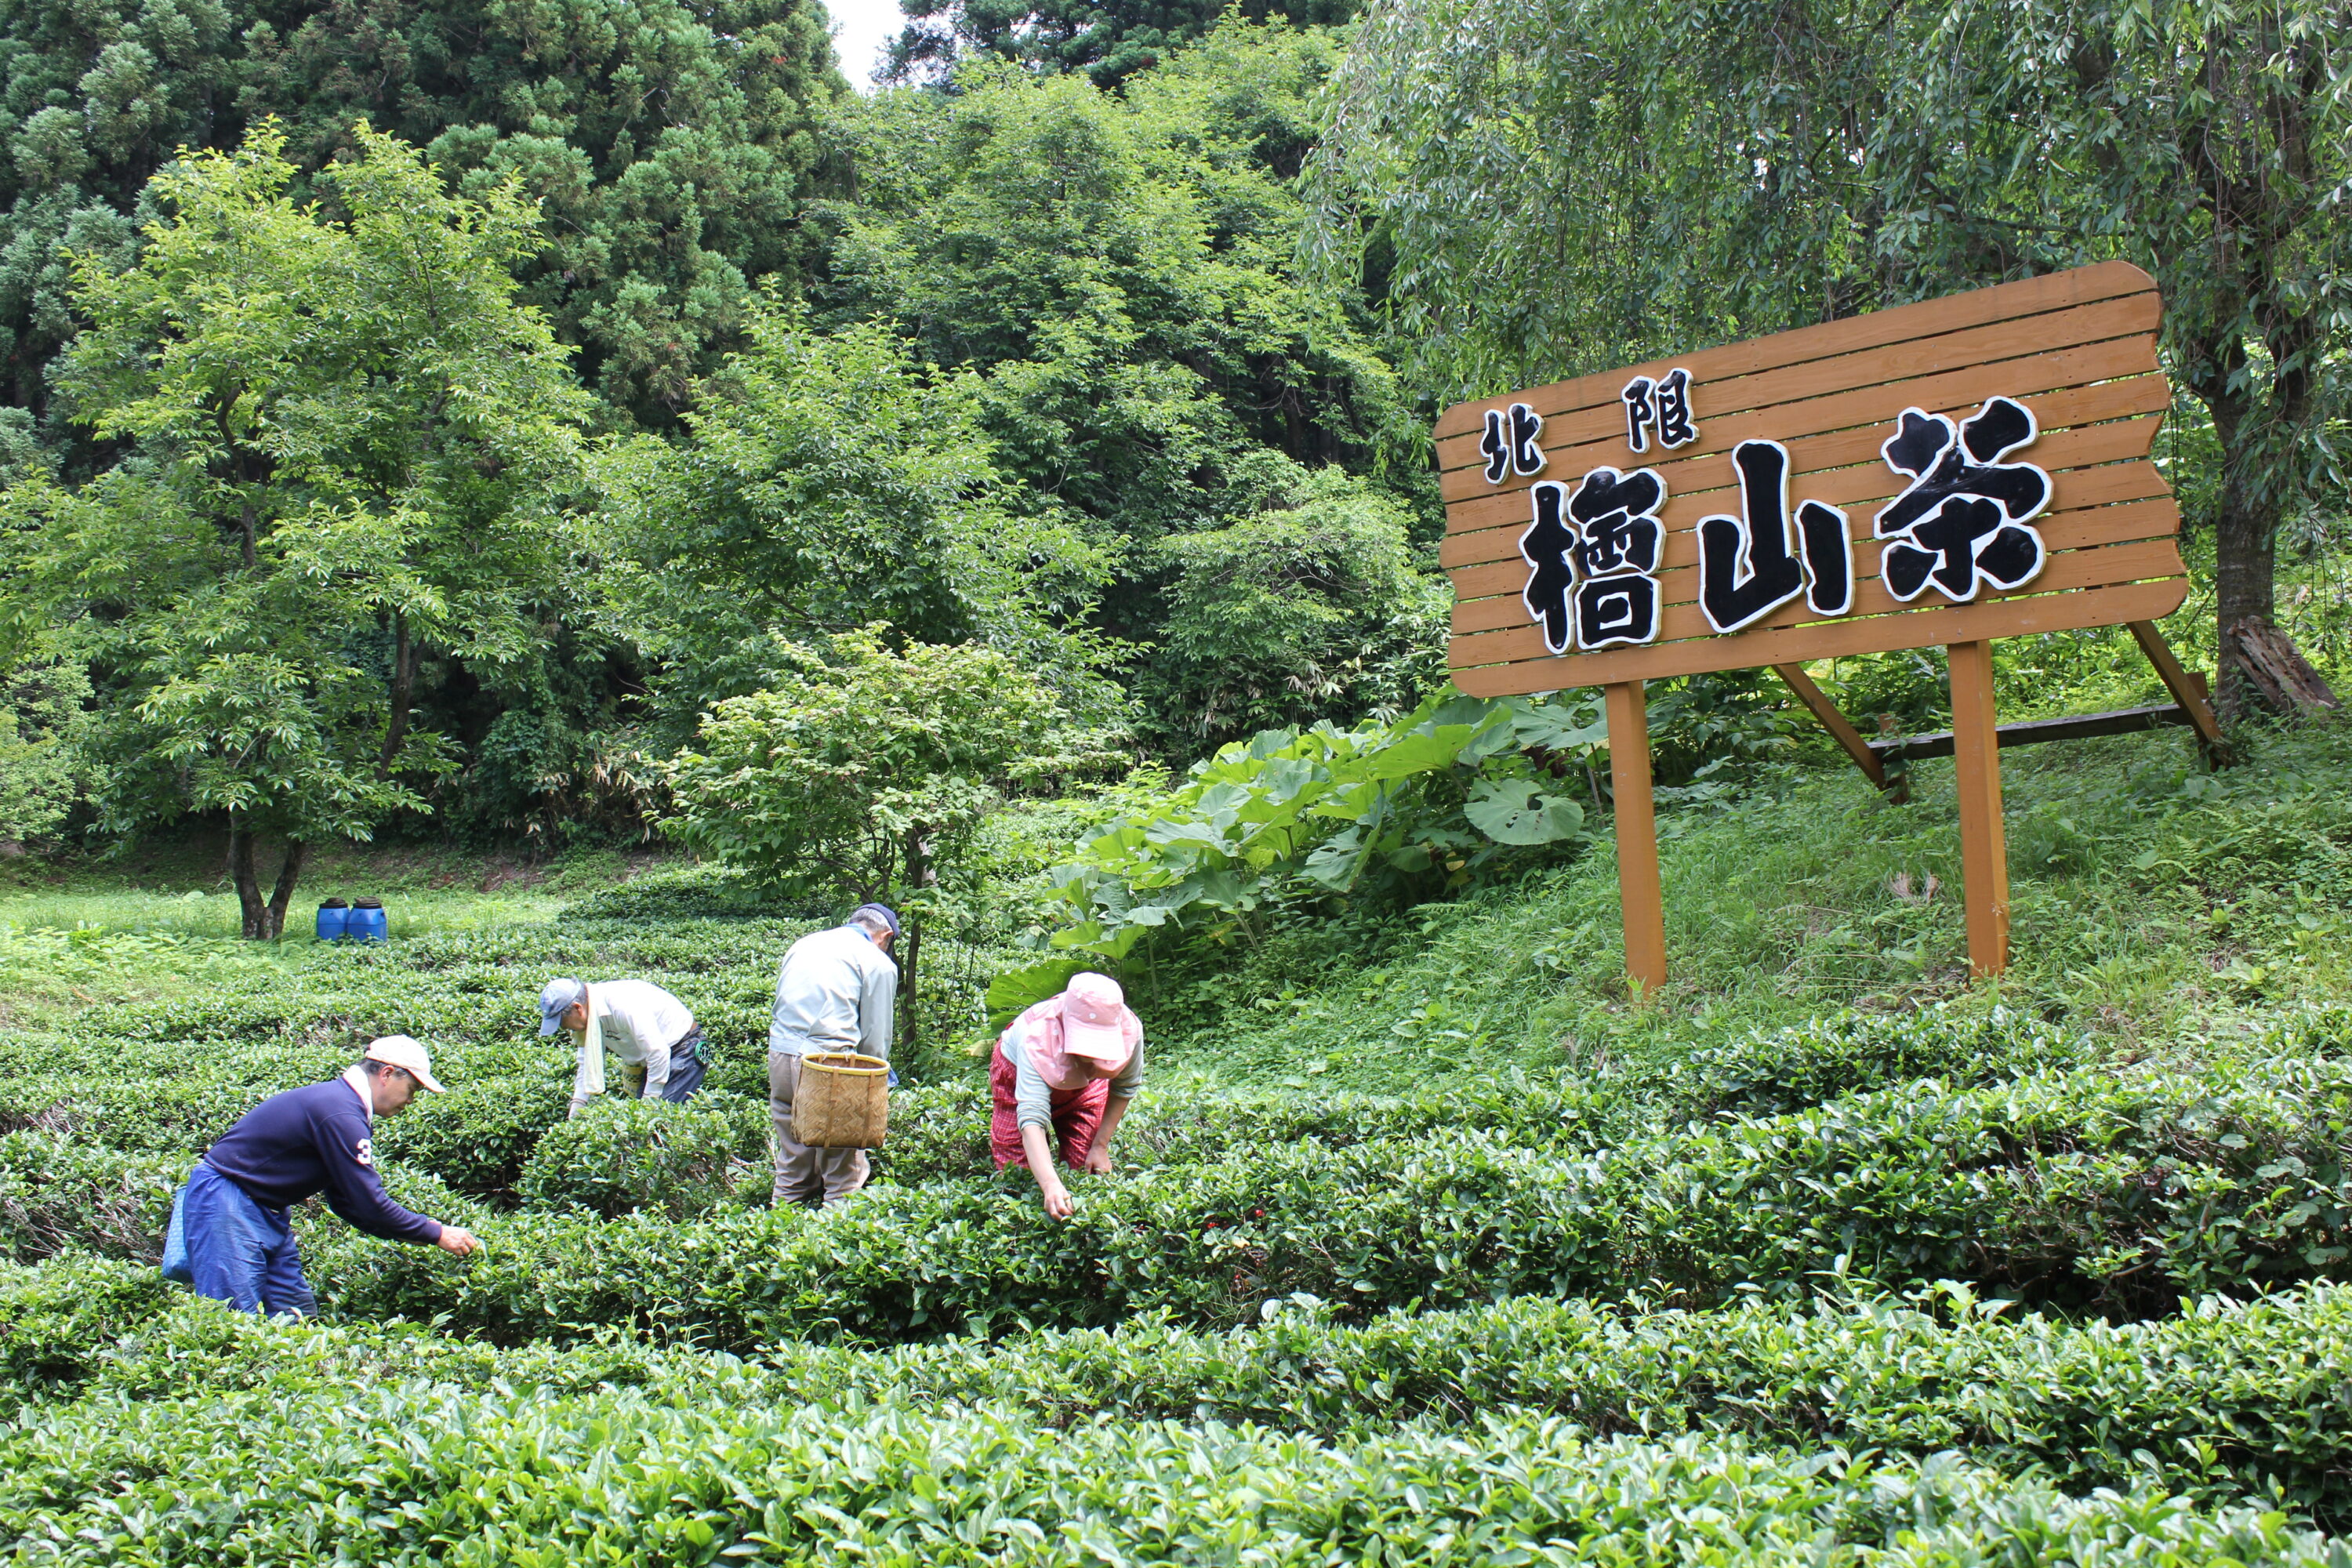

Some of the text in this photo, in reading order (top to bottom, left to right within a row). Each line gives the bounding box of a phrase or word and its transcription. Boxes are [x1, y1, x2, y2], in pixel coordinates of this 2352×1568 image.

[1480, 368, 1700, 485] 北限
[1519, 396, 2053, 655] 檜山茶
[357, 1138, 372, 1164] 3
